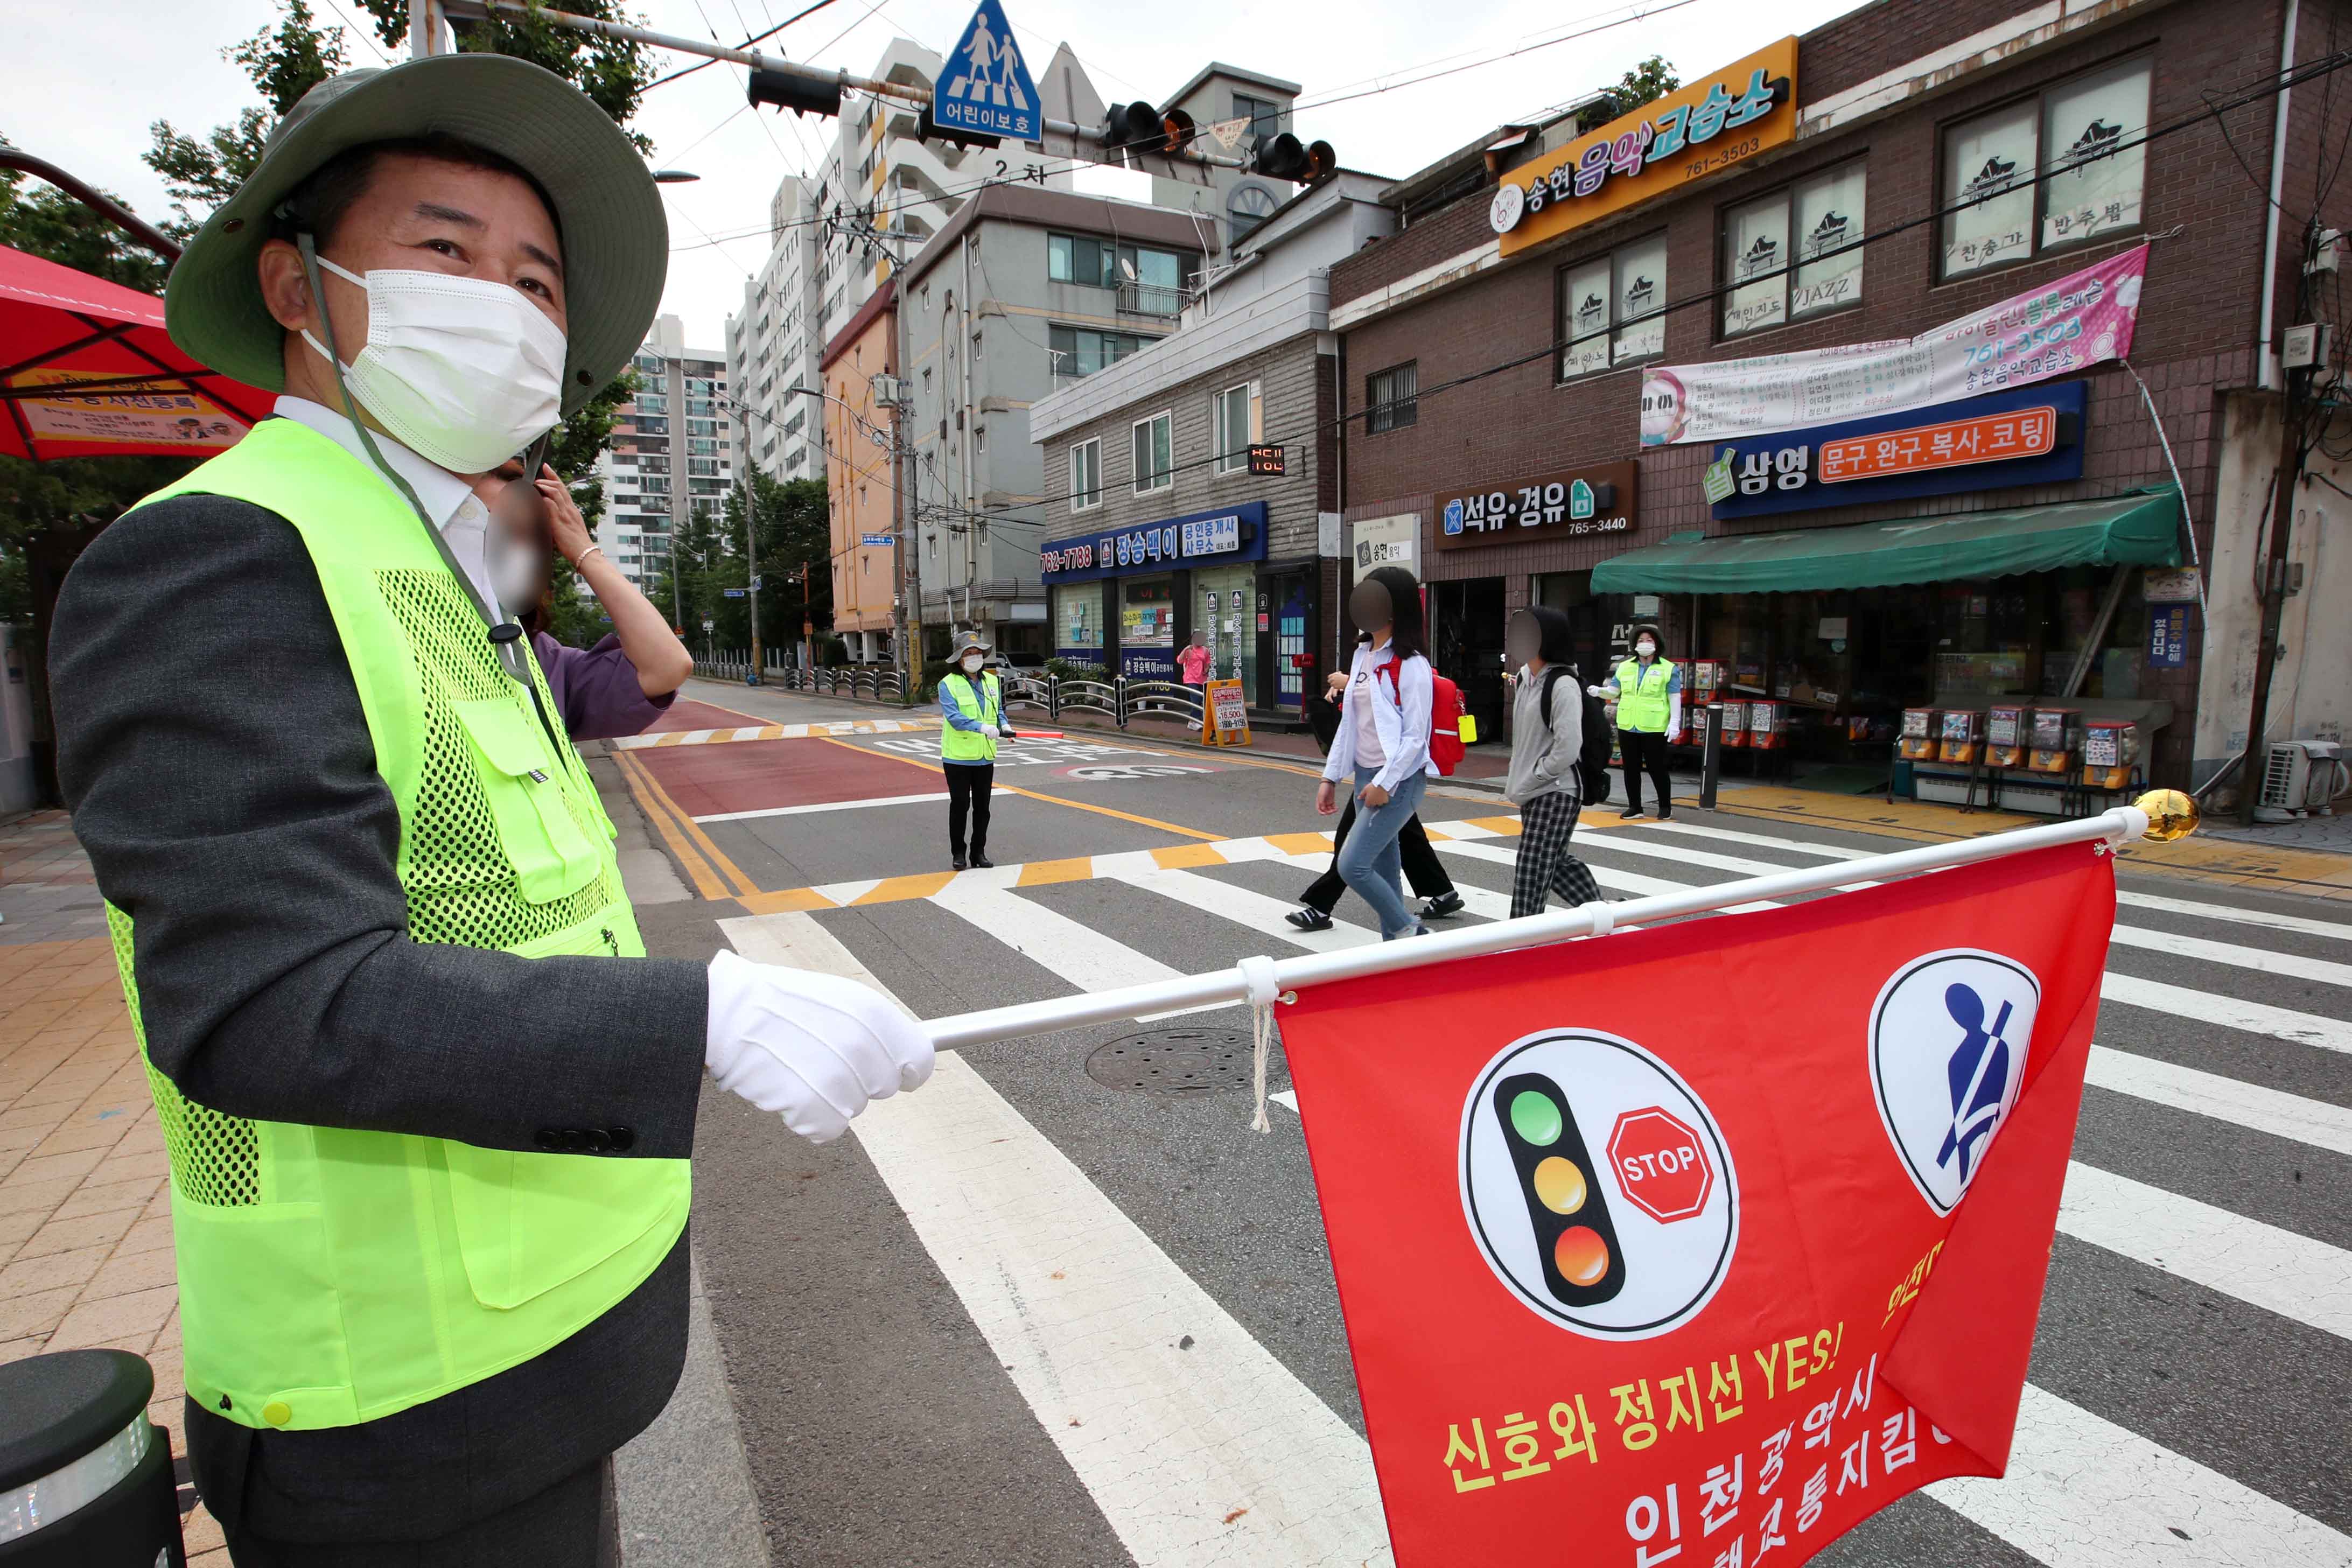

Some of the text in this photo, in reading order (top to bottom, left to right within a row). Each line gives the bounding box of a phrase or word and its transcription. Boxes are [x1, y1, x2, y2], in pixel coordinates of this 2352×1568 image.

[947, 103, 1030, 134] 어린이보호
[1685, 138, 1759, 178] 761-3503
[2054, 202, 2121, 235] 반주법
[1802, 278, 1849, 306] JAZZ
[1964, 317, 2081, 367] 761-3503
[1966, 345, 2074, 390] 송현음악교습소
[1739, 445, 1809, 495] 삼영
[1185, 517, 1235, 540] 공인중개사
[1569, 517, 1626, 534] 765-3440
[1040, 545, 1092, 573] 762-7788
[1116, 525, 1178, 566] 장승백이
[1185, 538, 1214, 555] 사무소
[1389, 545, 1399, 557] 음악
[2152, 619, 2166, 655] 있습니다
[1133, 661, 1157, 674] 장승백이
[1623, 1146, 1695, 1181] STOP
[1444, 1321, 1843, 1494] 신호와 정지선 YES!
[1625, 1352, 1877, 1568] 인천광역시
